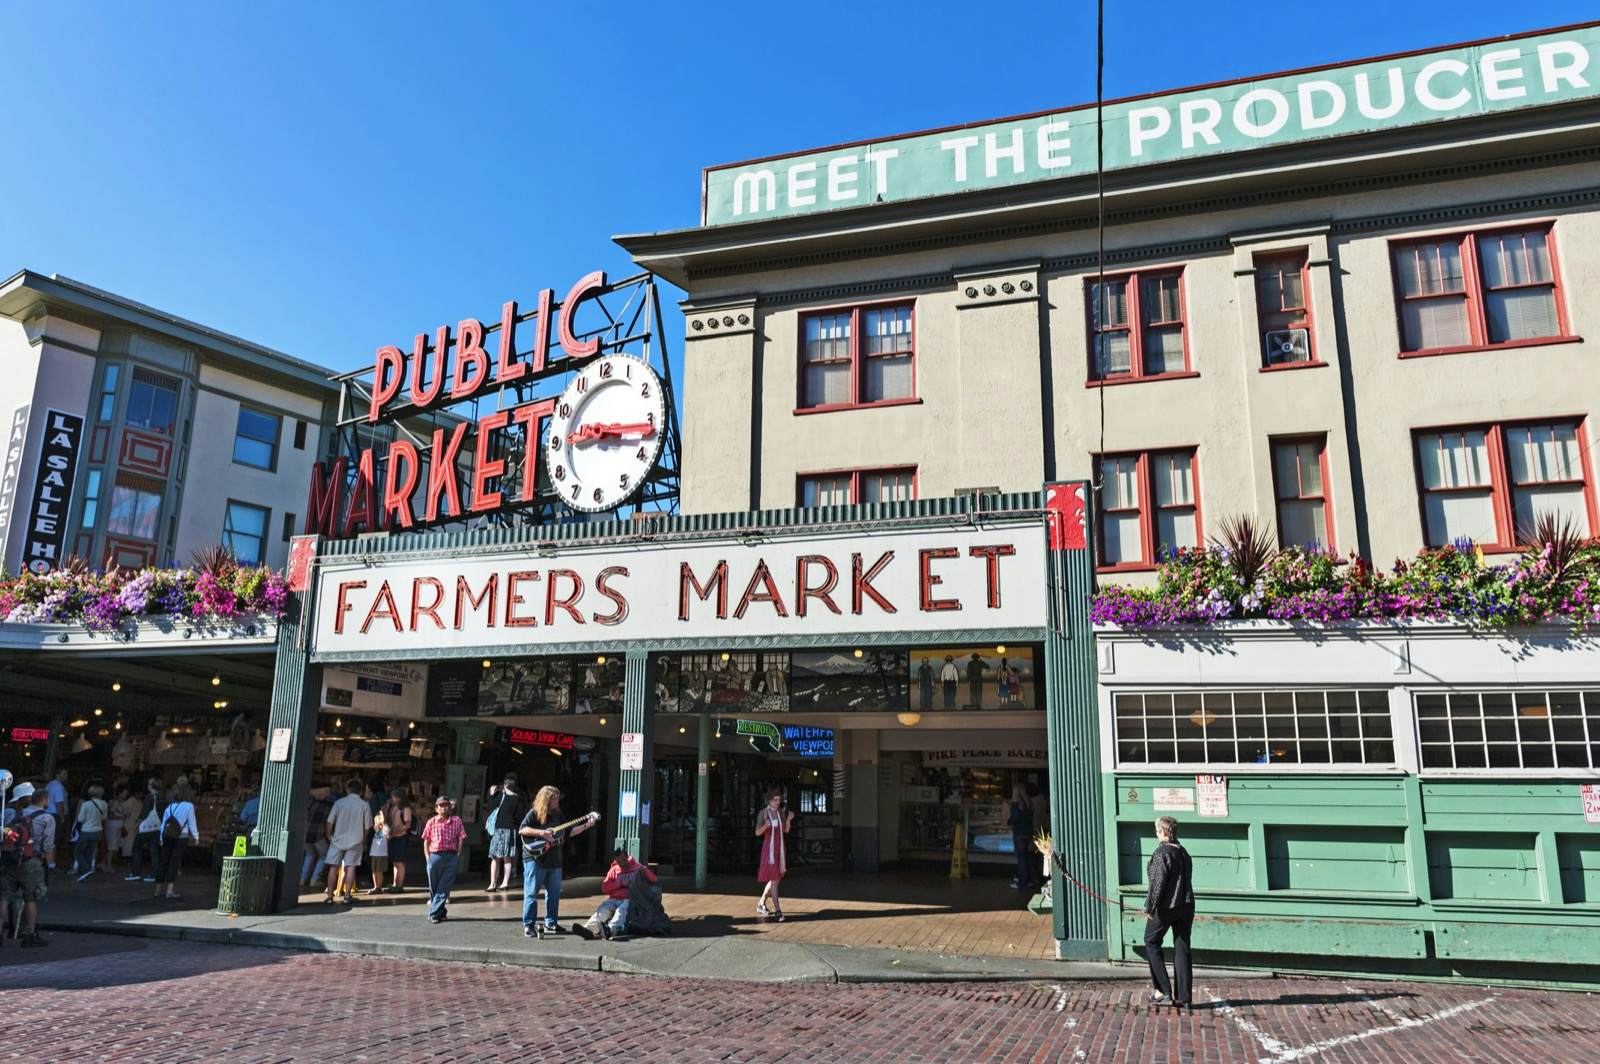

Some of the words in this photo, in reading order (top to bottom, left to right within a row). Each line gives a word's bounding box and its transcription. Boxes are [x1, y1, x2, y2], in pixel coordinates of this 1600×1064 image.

[732, 148, 899, 217] MEET
[940, 120, 1072, 183] THE
[1128, 39, 1591, 156] PRODUCER
[369, 271, 606, 422] PUBLIC
[600, 362, 613, 378] 12
[626, 365, 632, 378] 1
[577, 377, 589, 393] 11
[641, 383, 650, 398] 2
[559, 403, 571, 419] 10
[12, 411, 26, 443] LA
[647, 413, 654, 426] 3
[50, 415, 74, 449] LA
[551, 436, 561, 451] 9
[636, 446, 647, 461] 4
[305, 399, 556, 541] MARKET
[555, 465, 566, 481] 8
[0, 446, 19, 527] SALLE
[620, 474, 629, 489] 5
[34, 455, 69, 535] SALLE
[571, 484, 581, 499] 7
[593, 488, 604, 503] 6
[334, 566, 631, 635] FARMERS
[677, 543, 1017, 621] MARKET
[512, 727, 537, 741] SOUND
[928, 750, 958, 761] PIKE
[1199, 775, 1211, 783] NO
[1200, 784, 1224, 793] STOPS
